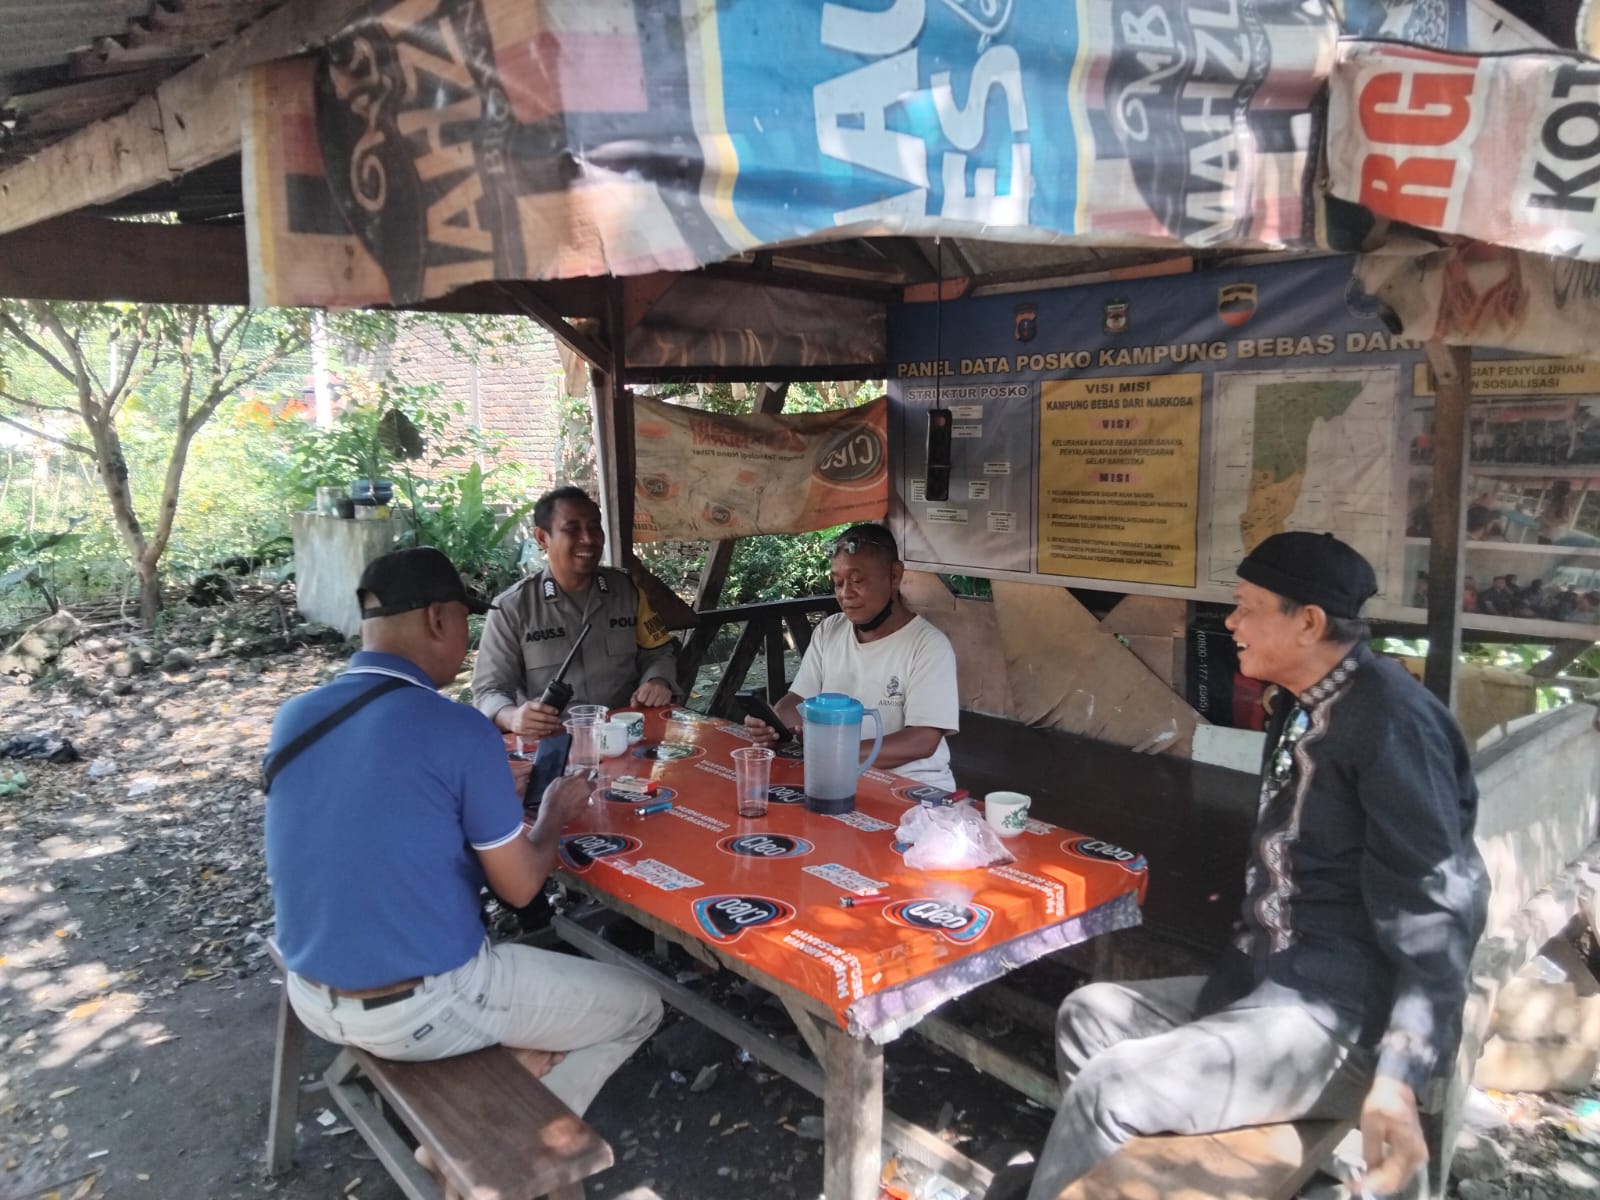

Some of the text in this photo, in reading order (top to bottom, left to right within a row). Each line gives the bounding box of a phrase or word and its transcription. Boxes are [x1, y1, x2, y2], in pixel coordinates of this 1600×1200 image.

[931, 45, 1032, 228] ES
[897, 360, 955, 377] PANEL
[960, 357, 1009, 374] DATA
[1016, 350, 1091, 371] POSKO
[1099, 341, 1227, 367] KAMPUNG
[1237, 334, 1335, 359] BEBAS
[1498, 363, 1585, 376] PENYULUHAN
[908, 385, 1028, 401] STRUKTUR POSKO
[1085, 381, 1152, 394] VISI MISI
[1483, 378, 1560, 390] SOSIALISASI
[1046, 397, 1193, 411] KAMPUNG BEBAS DARI NARKOBA
[1102, 419, 1131, 429] VISI
[573, 835, 618, 857] Cleo
[740, 835, 786, 856] Cleo
[1083, 841, 1135, 861] Cleo
[717, 898, 769, 925] Cleo
[908, 903, 969, 930] Cleo
